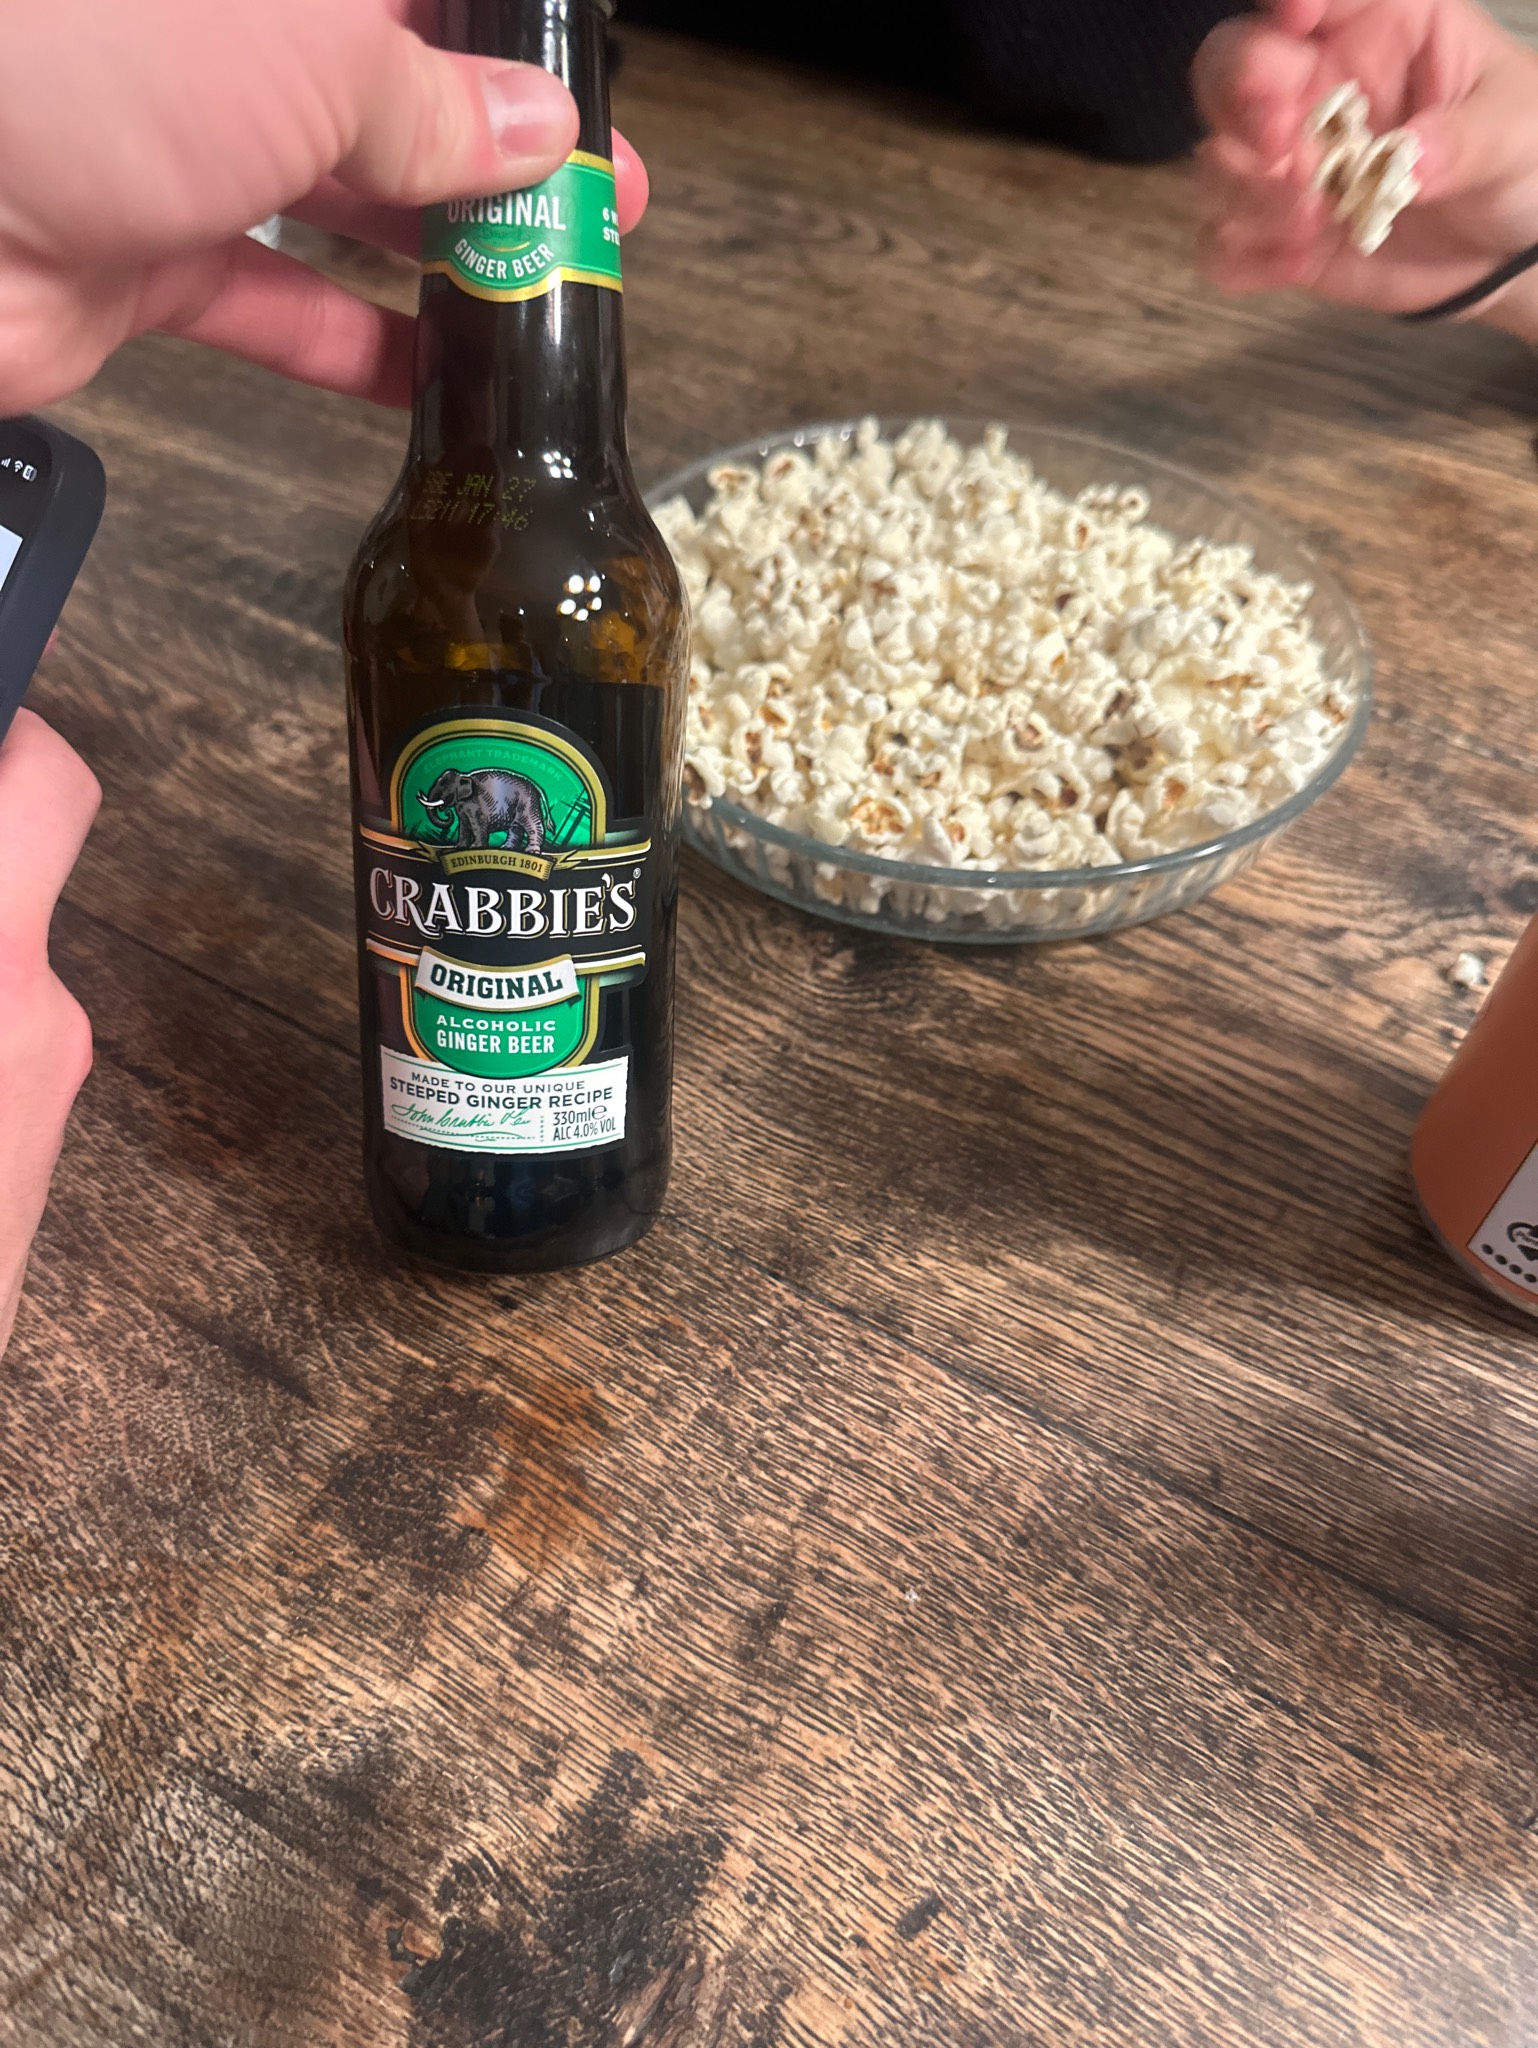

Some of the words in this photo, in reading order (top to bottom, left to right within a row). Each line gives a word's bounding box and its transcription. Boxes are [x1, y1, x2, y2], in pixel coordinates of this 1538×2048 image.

[602, 207, 609, 221] 6
[454, 239, 507, 279] GINGER
[512, 243, 555, 278] BEER
[457, 473, 494, 497] JAN
[502, 476, 537, 502] 27
[423, 750, 482, 773] ELEPHANT
[484, 750, 563, 781] TRADEMARK
[451, 855, 517, 869] EDINBURGH
[519, 860, 543, 873] 1801
[430, 963, 563, 1000] ORIGINAL
[436, 1014, 556, 1032] ALCOHOLIC
[436, 1029, 501, 1054] GINGER
[508, 1035, 555, 1054] BEER
[390, 1077, 460, 1105] STEEPED
[466, 1094, 541, 1109] GINGER
[549, 1087, 613, 1108] RECIPE
[411, 1071, 450, 1088] MADE
[455, 1081, 475, 1092] TO
[482, 1083, 516, 1094] OUR
[523, 1080, 585, 1094] UNIQUE
[553, 1126, 572, 1142] ALC
[573, 1122, 598, 1140] 4.0%
[600, 1118, 616, 1134] VOL
